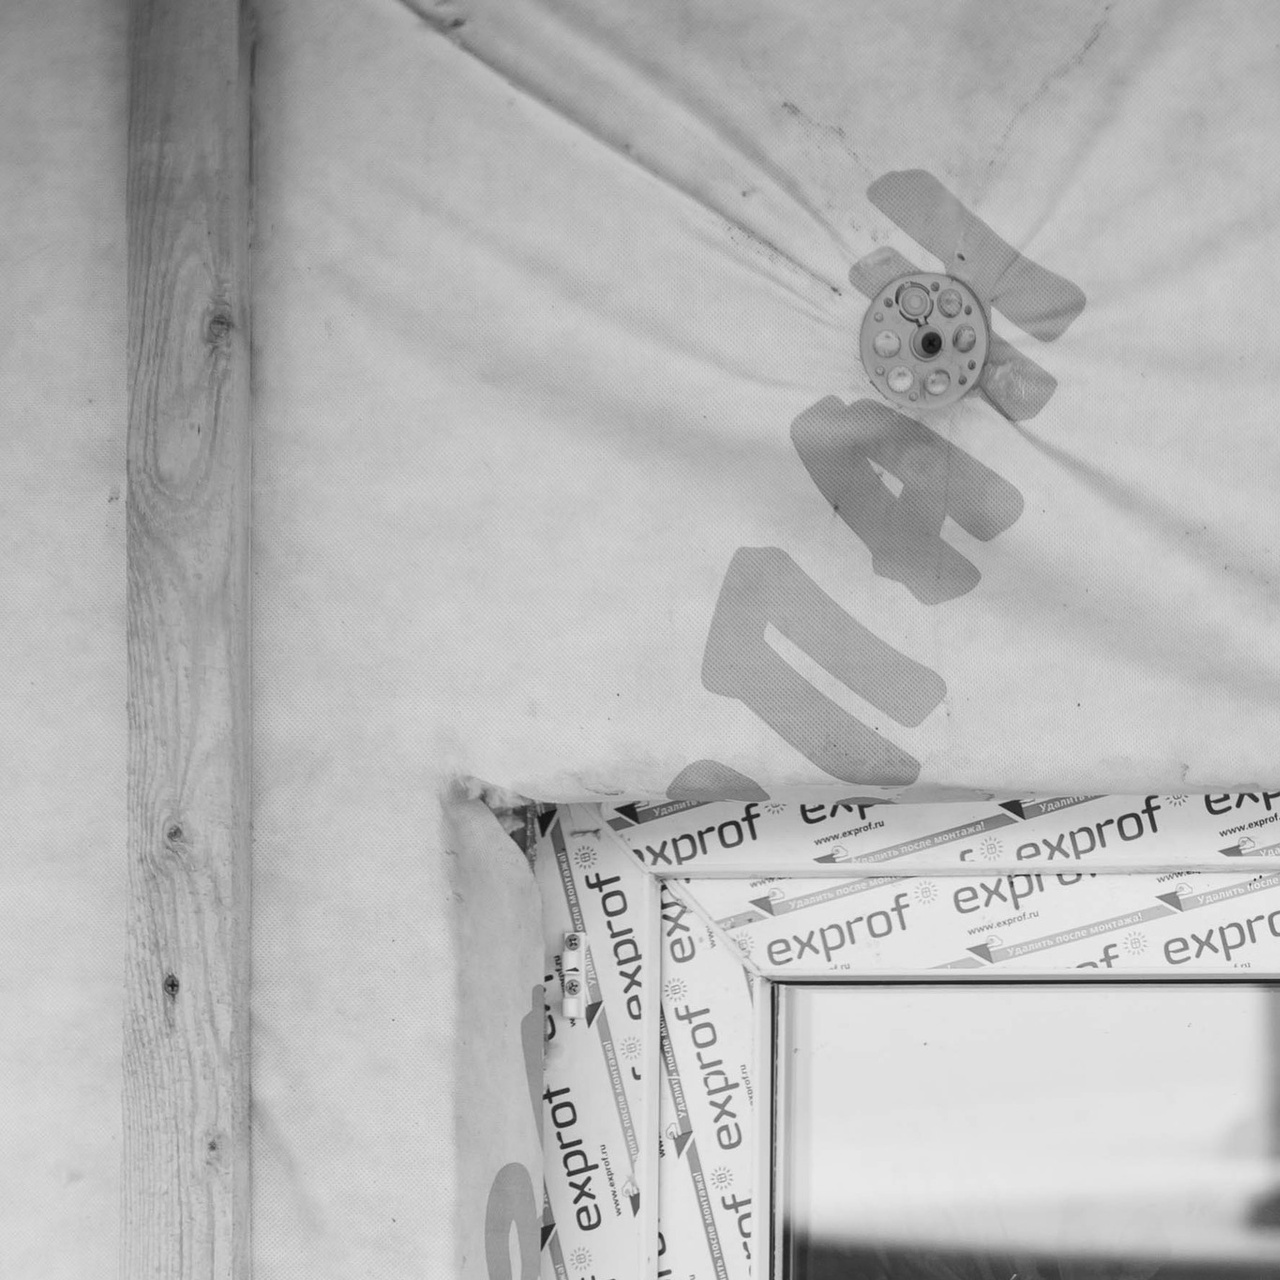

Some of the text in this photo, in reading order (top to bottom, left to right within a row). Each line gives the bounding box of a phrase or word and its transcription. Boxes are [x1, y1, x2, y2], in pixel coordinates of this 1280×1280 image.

[632, 803, 761, 866] xprof
[814, 820, 885, 846] www.exprof.ru
[903, 836, 933, 853] после
[933, 820, 985, 845] монтажа!
[1016, 795, 1161, 861] exprof
[557, 850, 584, 932] осле монтажа!
[585, 871, 642, 1021] exprof
[766, 892, 910, 967] exprof
[967, 909, 1040, 937] www.exprof.ru
[1006, 933, 1056, 958] Удалить
[1057, 925, 1089, 945] после
[1089, 910, 1143, 937] монтажа!
[603, 1040, 622, 1093] монтажа!
[675, 1004, 742, 1152] exprof
[543, 1086, 601, 1232] exprof
[599, 1144, 622, 1217] www.exprof.ru
[693, 1171, 713, 1225] монтажа!
[705, 1225, 721, 1258] после
